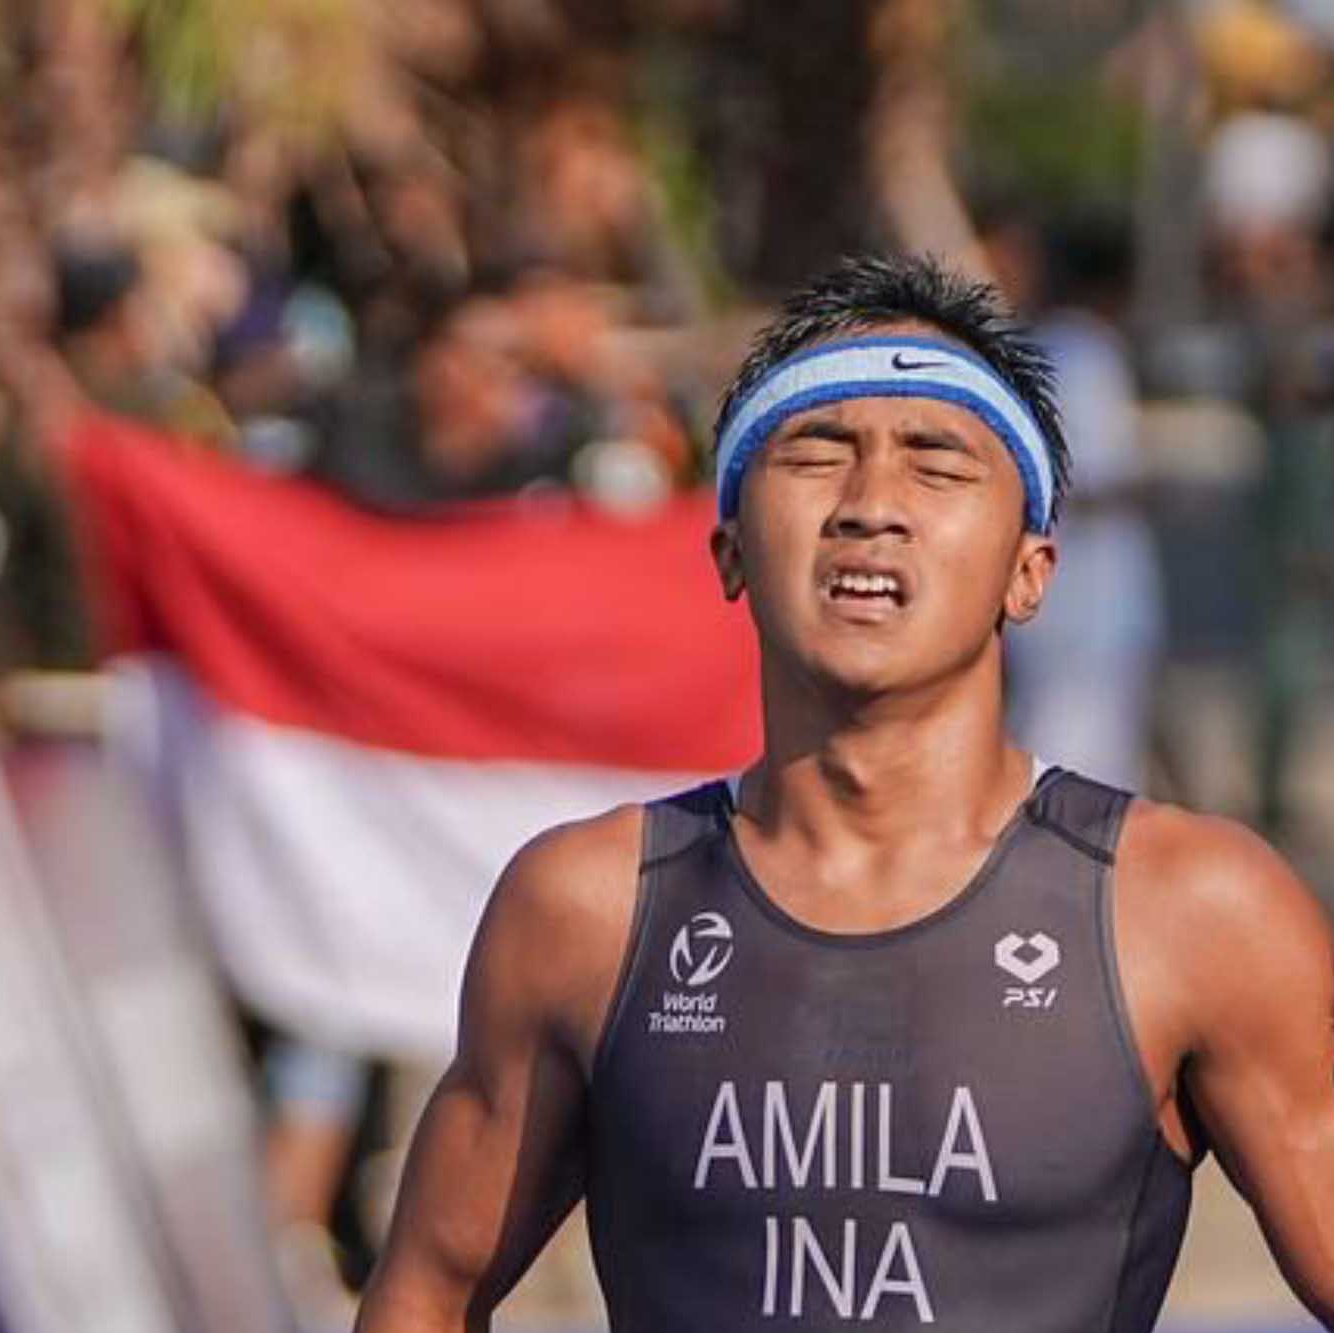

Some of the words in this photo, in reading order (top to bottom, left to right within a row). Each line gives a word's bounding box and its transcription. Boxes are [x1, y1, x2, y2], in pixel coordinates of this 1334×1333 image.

[648, 1011, 726, 1034] Triathlon
[662, 990, 718, 1013] World
[693, 1080, 998, 1201] AMILA
[761, 1217, 935, 1323] INA
